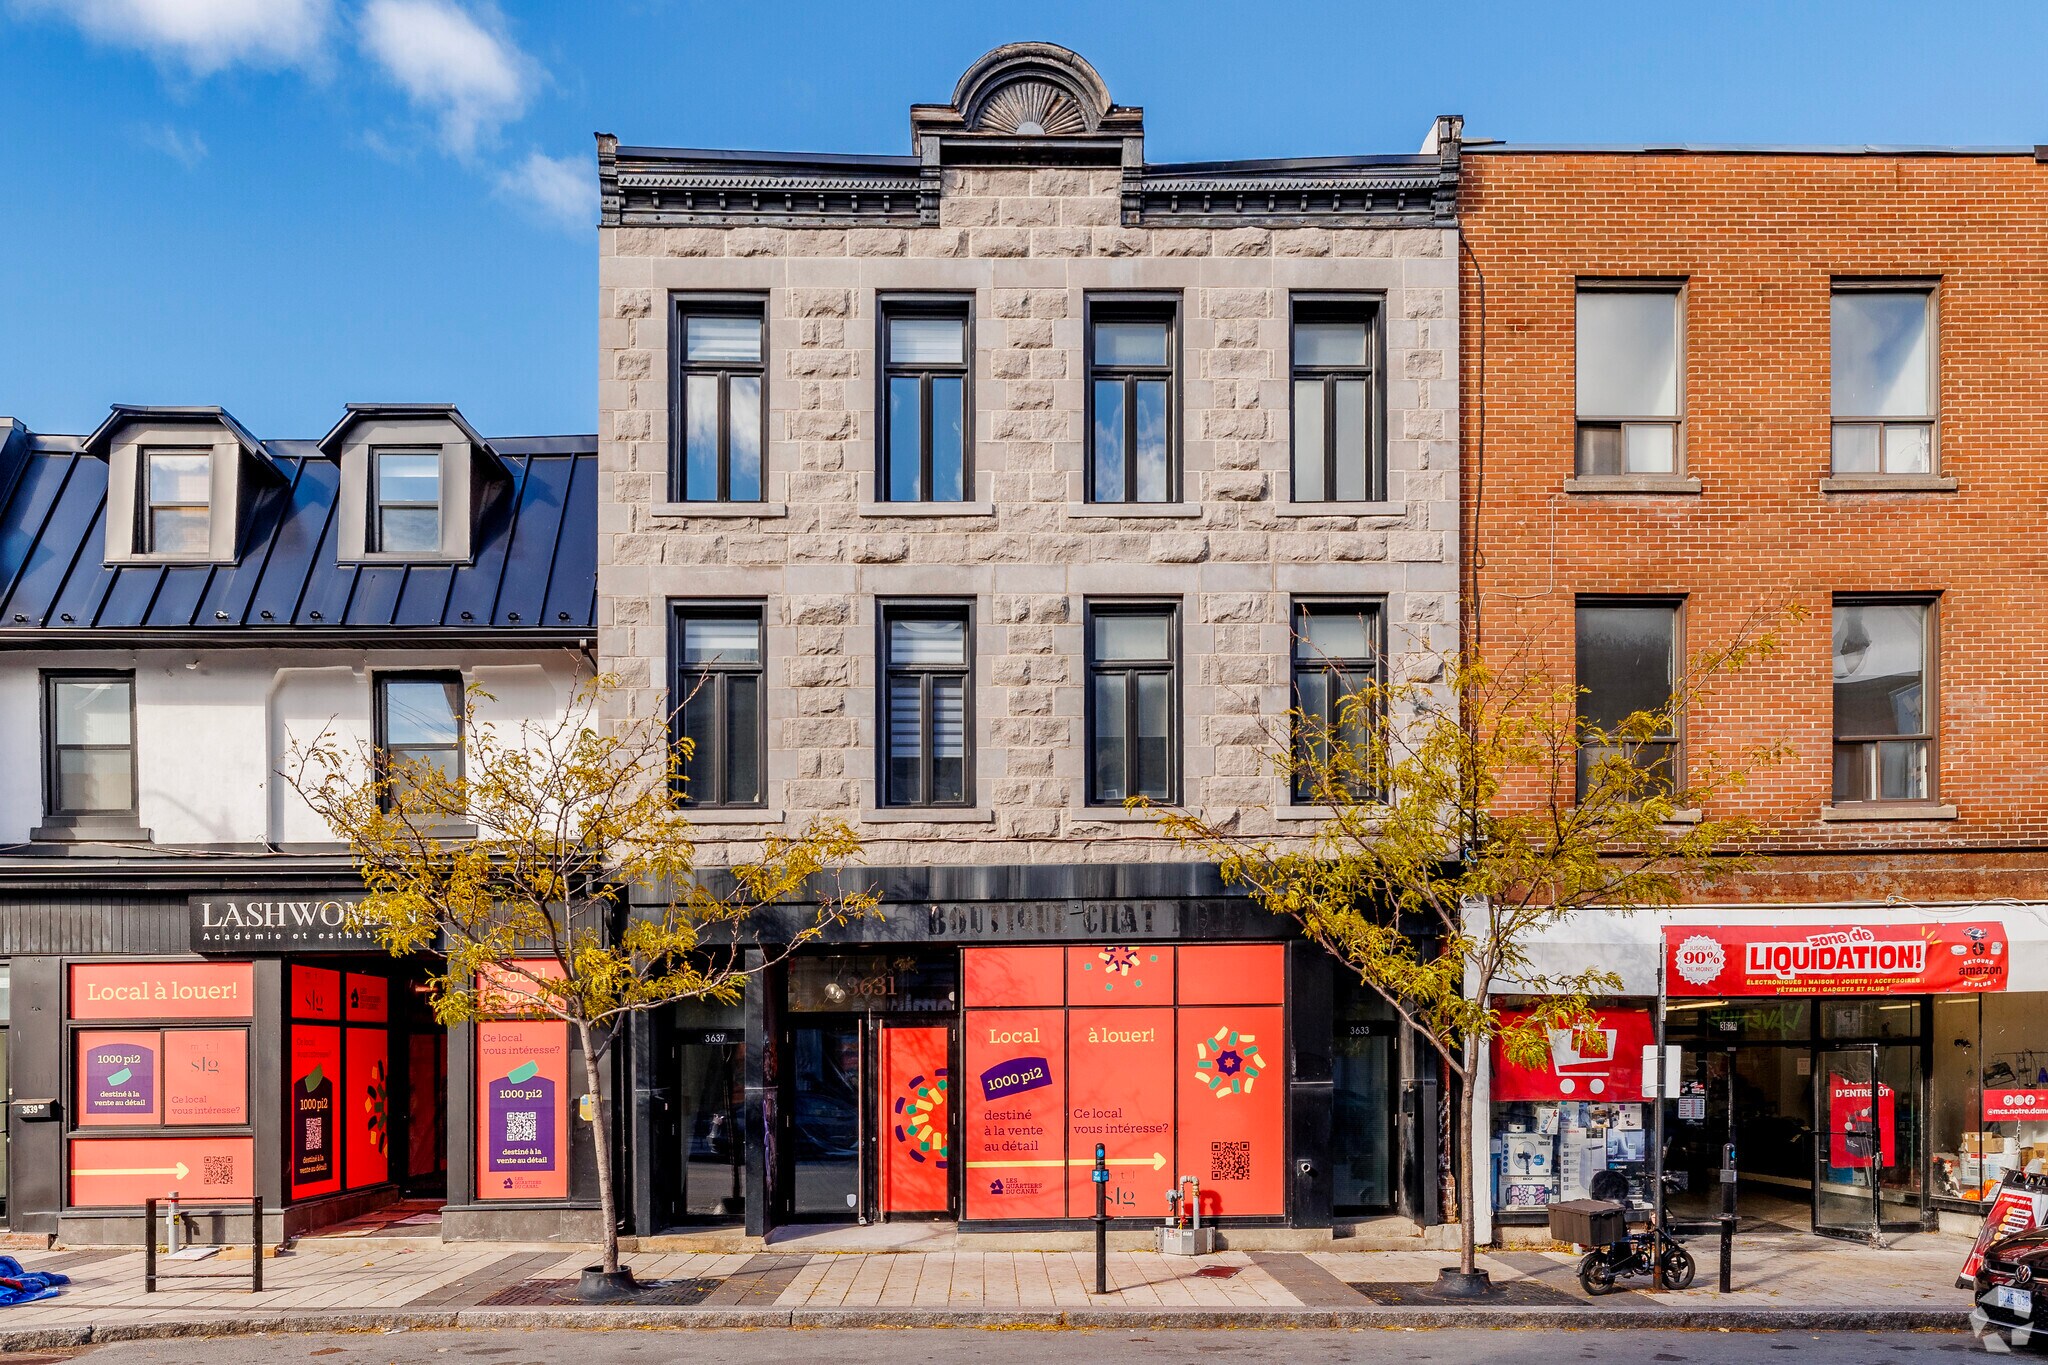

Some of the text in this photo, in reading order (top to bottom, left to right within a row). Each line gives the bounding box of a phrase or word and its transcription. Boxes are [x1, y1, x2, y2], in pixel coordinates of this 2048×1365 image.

[203, 931, 281, 940] Académie
[1811, 929, 1872, 947] zone de
[1683, 951, 1720, 965] 90%
[1750, 945, 1922, 976] LIQUIDATION!
[1963, 958, 1994, 966] RETOURS
[1959, 966, 2003, 976] amazon
[88, 981, 237, 1001] Local à louer!
[847, 976, 897, 996] 3631
[1776, 985, 1816, 993] VÊTEMENTS
[989, 1028, 1154, 1043] Local à louer!
[1350, 1026, 1370, 1035] 3633
[483, 1034, 522, 1042] Ce local
[705, 1034, 725, 1043] 3637
[508, 1046, 560, 1055] intéresse?
[97, 1055, 141, 1064] 1000 pi2
[987, 1067, 1043, 1091] 1000 pi2
[499, 1089, 543, 1100] 1000 pi2
[1835, 1086, 1890, 1097] D'ENTREÔT
[172, 1096, 207, 1104] Ce local
[300, 1097, 328, 1111] 1000 pi2
[22, 1105, 38, 1114] 3639
[195, 1106, 241, 1115] intéresse?
[984, 1109, 1032, 1120] destiné
[1073, 1107, 1123, 1118] Ce local
[984, 1125, 1044, 1135] à la vente
[1073, 1122, 1169, 1134] vous intéresse?
[984, 1140, 1039, 1151] au détail
